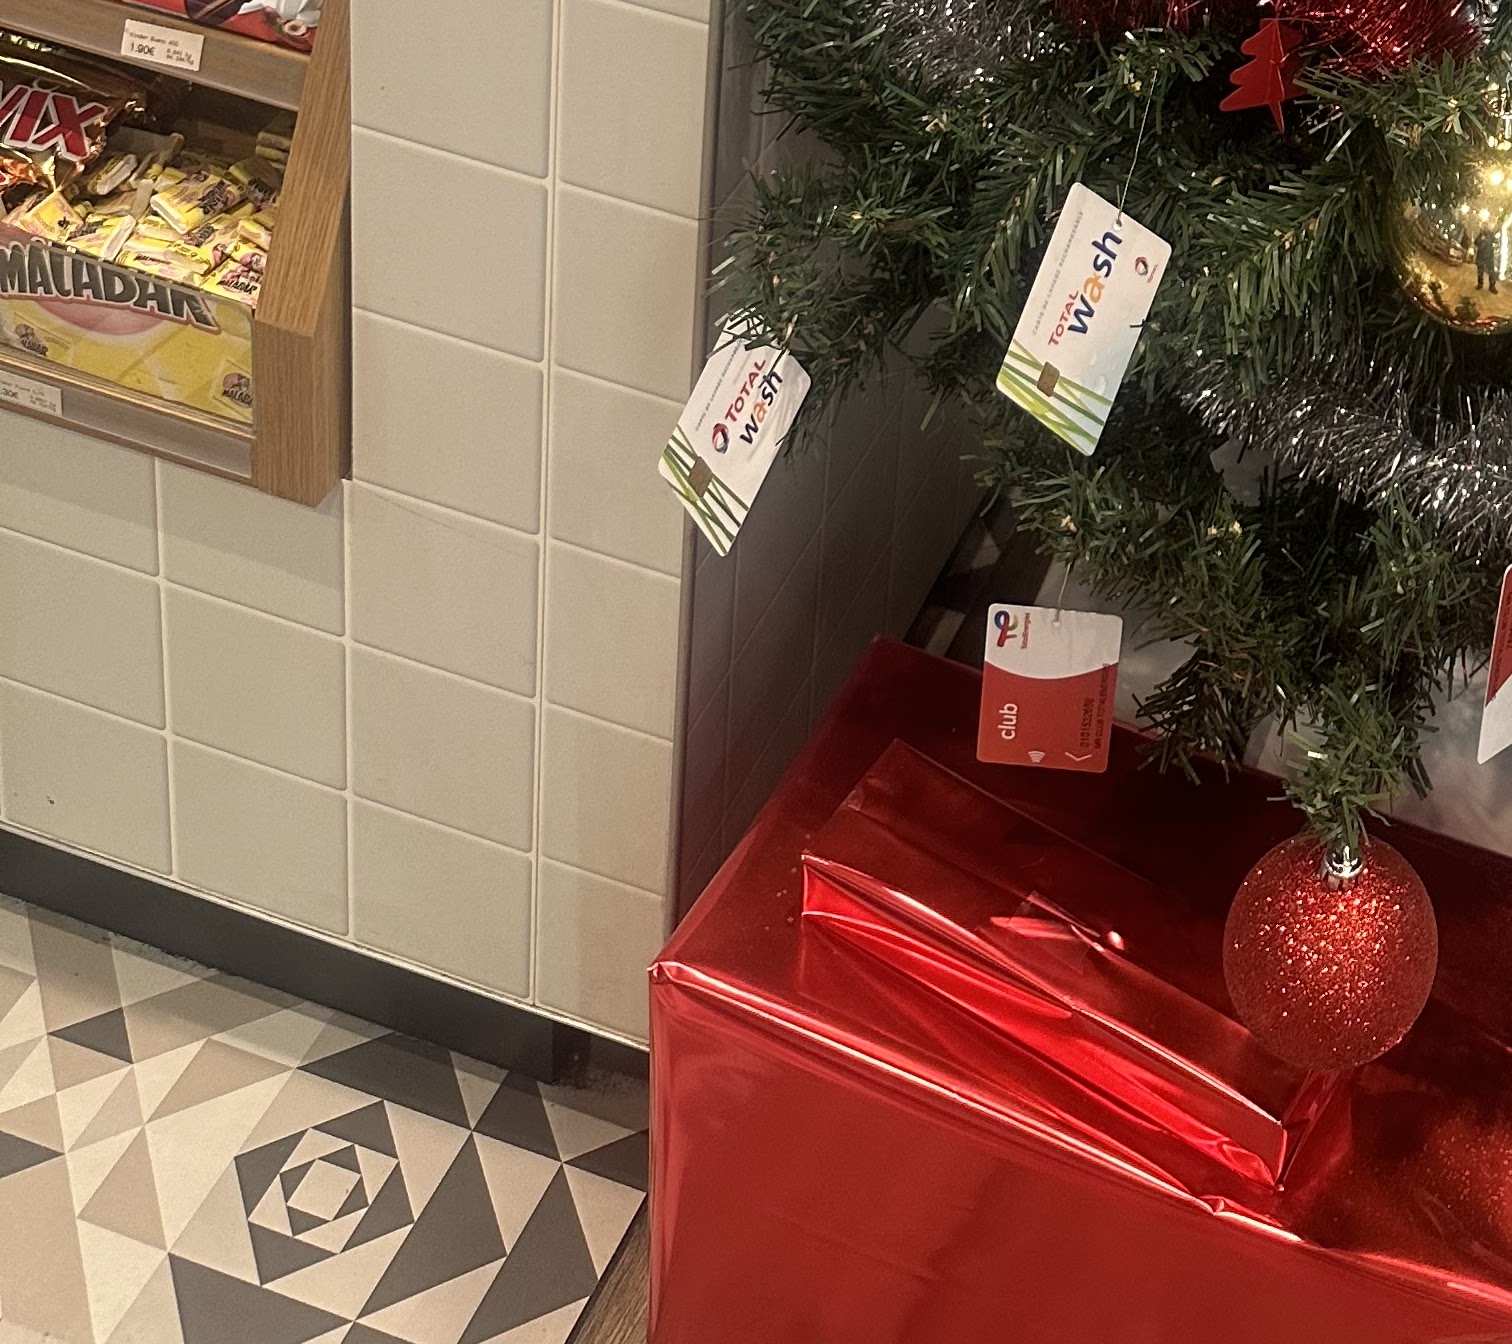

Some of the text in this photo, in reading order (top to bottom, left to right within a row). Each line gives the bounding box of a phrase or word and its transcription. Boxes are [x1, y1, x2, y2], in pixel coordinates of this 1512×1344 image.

[1067, 230, 1123, 334] wash
[1047, 290, 1079, 346] TOTAL
[725, 359, 767, 422] TOTAL
[740, 370, 783, 444] wash
[998, 703, 1018, 740] club
